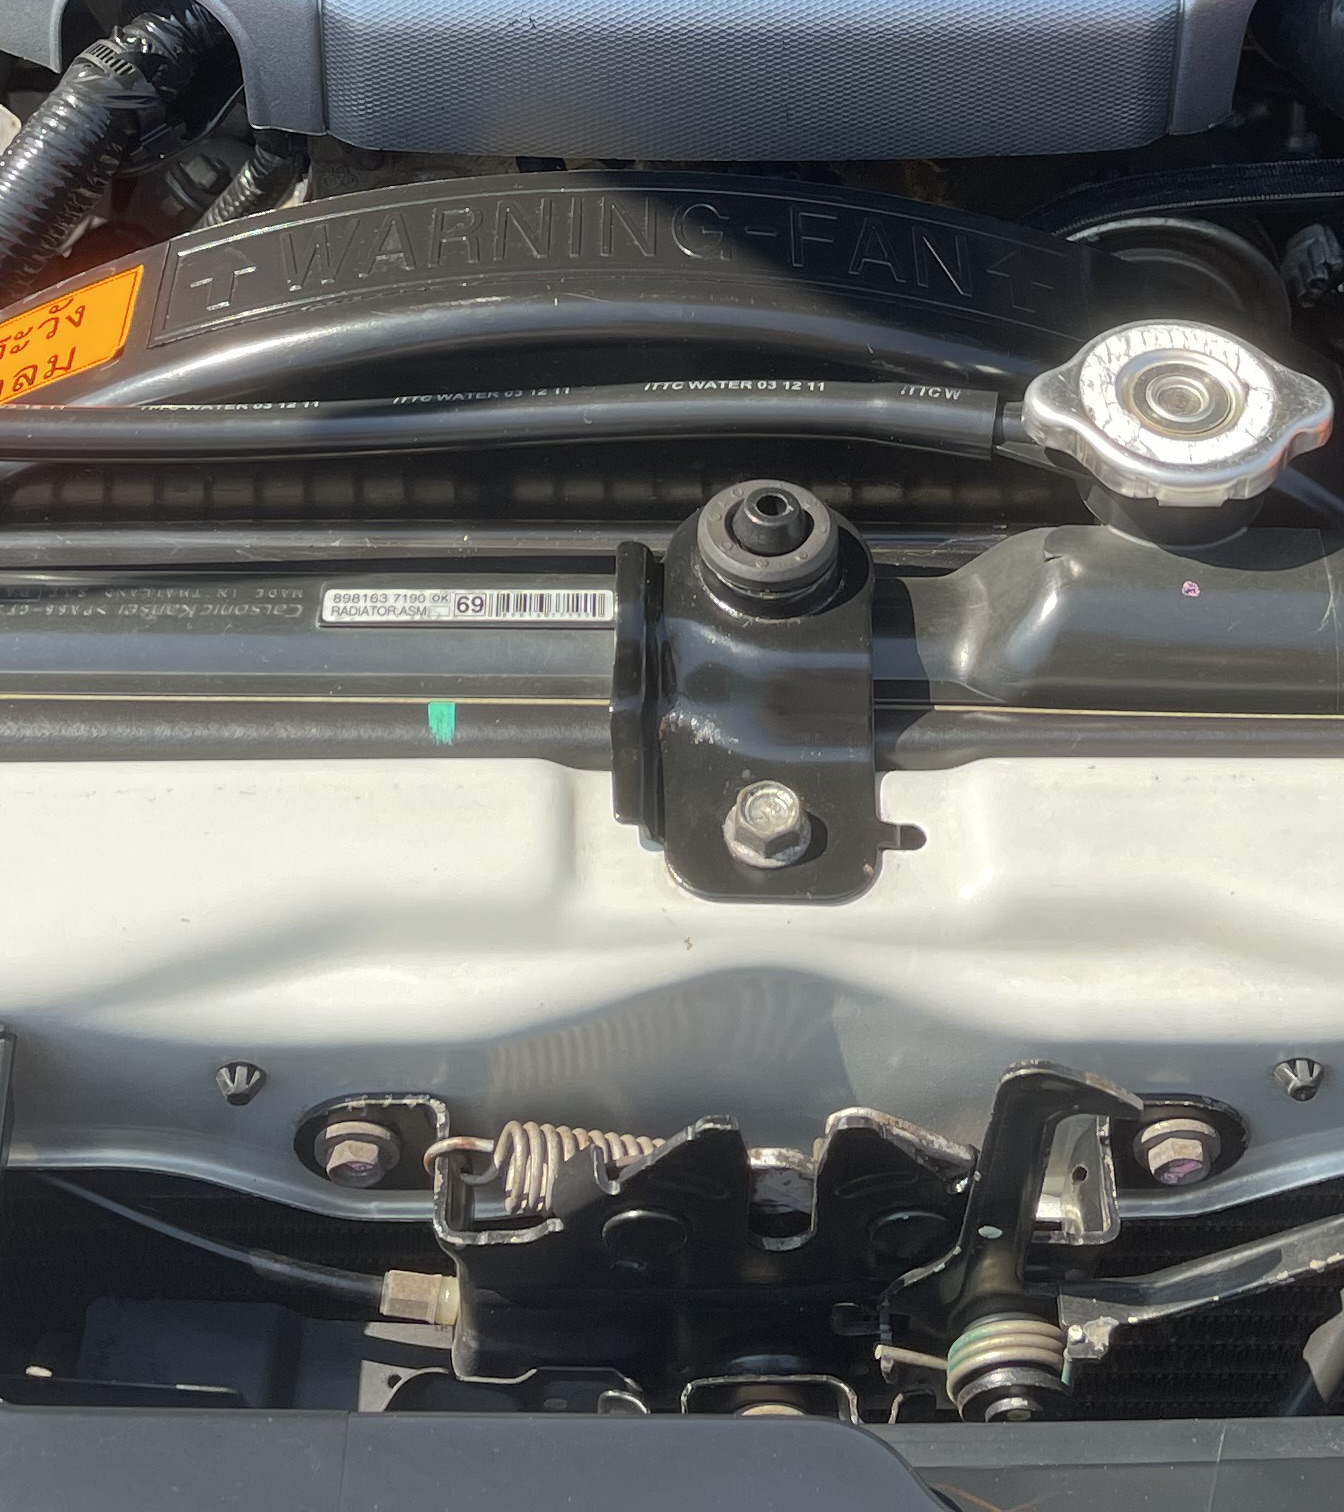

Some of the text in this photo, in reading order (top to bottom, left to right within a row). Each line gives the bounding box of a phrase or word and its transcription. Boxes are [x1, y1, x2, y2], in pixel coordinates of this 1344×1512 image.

[688, 380, 753, 390] WATER
[756, 380, 778, 390] 03
[782, 380, 803, 391] 12
[806, 381, 826, 392] 11
[436, 391, 500, 402] WATER
[503, 389, 524, 399] 03
[529, 387, 548, 397] 12
[552, 386, 571, 396] 11
[254, 588, 304, 598] MADE
[332, 593, 449, 604] 898163 7190 OK
[456, 595, 485, 614] 69
